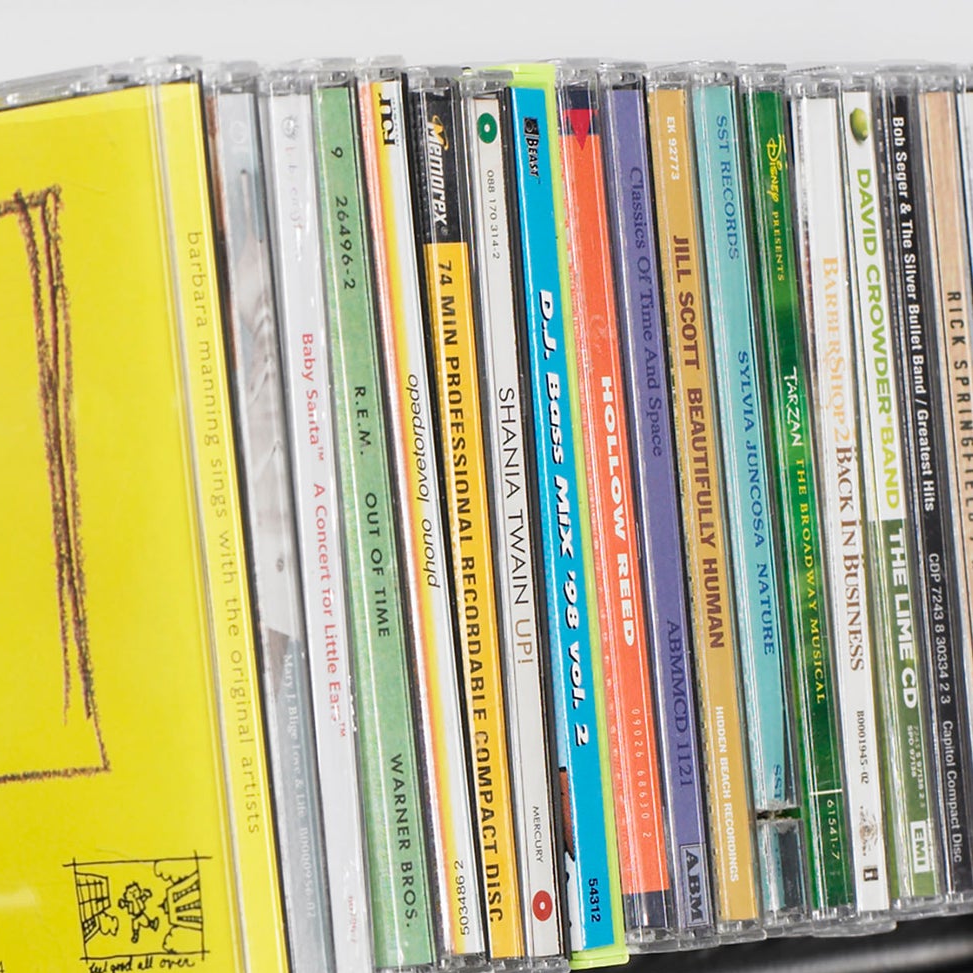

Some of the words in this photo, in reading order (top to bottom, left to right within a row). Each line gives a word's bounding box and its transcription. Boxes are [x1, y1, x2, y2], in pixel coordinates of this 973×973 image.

[331, 147, 343, 159] 9
[667, 116, 676, 134] EK
[717, 114, 729, 152] SST
[892, 117, 905, 147] Bob
[486, 170, 496, 194] 088
[526, 138, 540, 178] BEAST
[668, 138, 680, 181] 92773
[766, 134, 786, 203] Disney
[895, 151, 909, 199] Seger
[489, 197, 498, 222] 170
[629, 166, 646, 250] Classics
[721, 161, 740, 261] RECORDS
[857, 169, 878, 257] DAVID
[900, 202, 913, 215] &
[901, 220, 914, 249] The
[335, 195, 356, 290] 26496-2
[490, 224, 501, 260] 314-2
[637, 255, 654, 283] Of
[673, 235, 692, 284] JILL
[772, 211, 785, 282] PRESENTS
[187, 231, 208, 329] barbara
[439, 260, 452, 286] 74
[904, 253, 917, 301] Silver
[443, 297, 459, 346] MIN
[540, 289, 557, 360] D.J.
[640, 285, 654, 341] Time
[679, 291, 700, 370] SCOTT
[823, 257, 846, 425] BARBERSHOP
[908, 304, 923, 350] Bullet
[947, 290, 966, 346] RICK
[301, 333, 315, 383] Baby
[644, 346, 661, 391] And
[912, 354, 927, 395] Band
[199, 339, 220, 447] manning
[546, 372, 565, 464] Bass
[738, 351, 755, 433] SYLVIA
[784, 366, 803, 447] TARZAN
[915, 398, 928, 407] /
[354, 386, 369, 456] R.E.M.
[406, 373, 429, 502] lovetorpedo
[445, 356, 473, 543] PROFESSIONAL
[499, 387, 522, 498] SHANIA
[646, 396, 663, 457] Space
[834, 427, 850, 443] 2
[916, 408, 935, 478] Greatest
[211, 457, 228, 518] sings
[313, 483, 325, 498] A
[686, 387, 717, 549] BEAUTIFULLY
[745, 440, 766, 548] JUNCOSA
[795, 459, 808, 495] THE
[836, 446, 855, 513] BACK
[921, 480, 936, 513] Hits
[364, 492, 381, 538] OUT
[555, 475, 575, 559] Mix
[601, 376, 626, 542] HOLLOW
[616, 552, 635, 647] REED
[841, 520, 858, 547] IN
[220, 531, 236, 584] with
[315, 504, 330, 584] Concert
[371, 547, 384, 572] OF
[420, 518, 440, 588] phono
[507, 508, 530, 606] TWAIN
[799, 503, 818, 613] BROADWAY
[890, 528, 908, 586] THE
[929, 552, 941, 583] CDP
[225, 594, 240, 637] the
[321, 588, 333, 618] for
[375, 585, 390, 638] TIME
[563, 570, 581, 630] '98
[702, 557, 726, 649] HUMAN
[756, 563, 776, 656] NATURE
[843, 554, 865, 672] BUSINESS
[895, 592, 914, 661] LIME
[931, 586, 945, 620] 7243
[935, 623, 945, 633] 8
[324, 623, 339, 676] Little
[464, 556, 486, 721] RECORDABLE
[514, 618, 534, 664] UP!
[810, 618, 827, 705] MUSICAL
[935, 637, 948, 679] 30334
[230, 651, 254, 744] original
[667, 619, 688, 733] ABMMCD
[679, 739, 693, 787] 1121
[901, 667, 917, 709] CD
[939, 683, 950, 691] 2
[940, 695, 951, 705] 3
[282, 653, 294, 688] Mary
[288, 706, 300, 740] Blige
[296, 794, 308, 818] Life
[575, 724, 590, 747] 2
[714, 705, 727, 752] HIDDEN
[856, 710, 870, 785] B0001945-02
[942, 720, 957, 767] Capitol
[242, 756, 260, 834] artists
[475, 730, 499, 854] COMPACT
[631, 708, 643, 758] 09026
[637, 769, 648, 821] 68630
[643, 831, 653, 839] 2
[720, 757, 731, 798] BEACH
[773, 764, 783, 799] SST
[946, 769, 962, 830] Compact
[391, 753, 412, 852] WARNER
[826, 799, 841, 861] 61541-7
[532, 805, 544, 863] MERCURY
[723, 800, 740, 882] RECORDINGS
[914, 827, 927, 866] EMI
[953, 832, 964, 863] Disc
[454, 859, 464, 870] 2
[486, 861, 504, 923] DISC
[684, 849, 705, 923] ABM
[401, 860, 419, 928] BROS.
[455, 875, 470, 936] 503486
[587, 877, 601, 923] 54312
[137, 957, 153, 972] all
[159, 958, 196, 971] over
